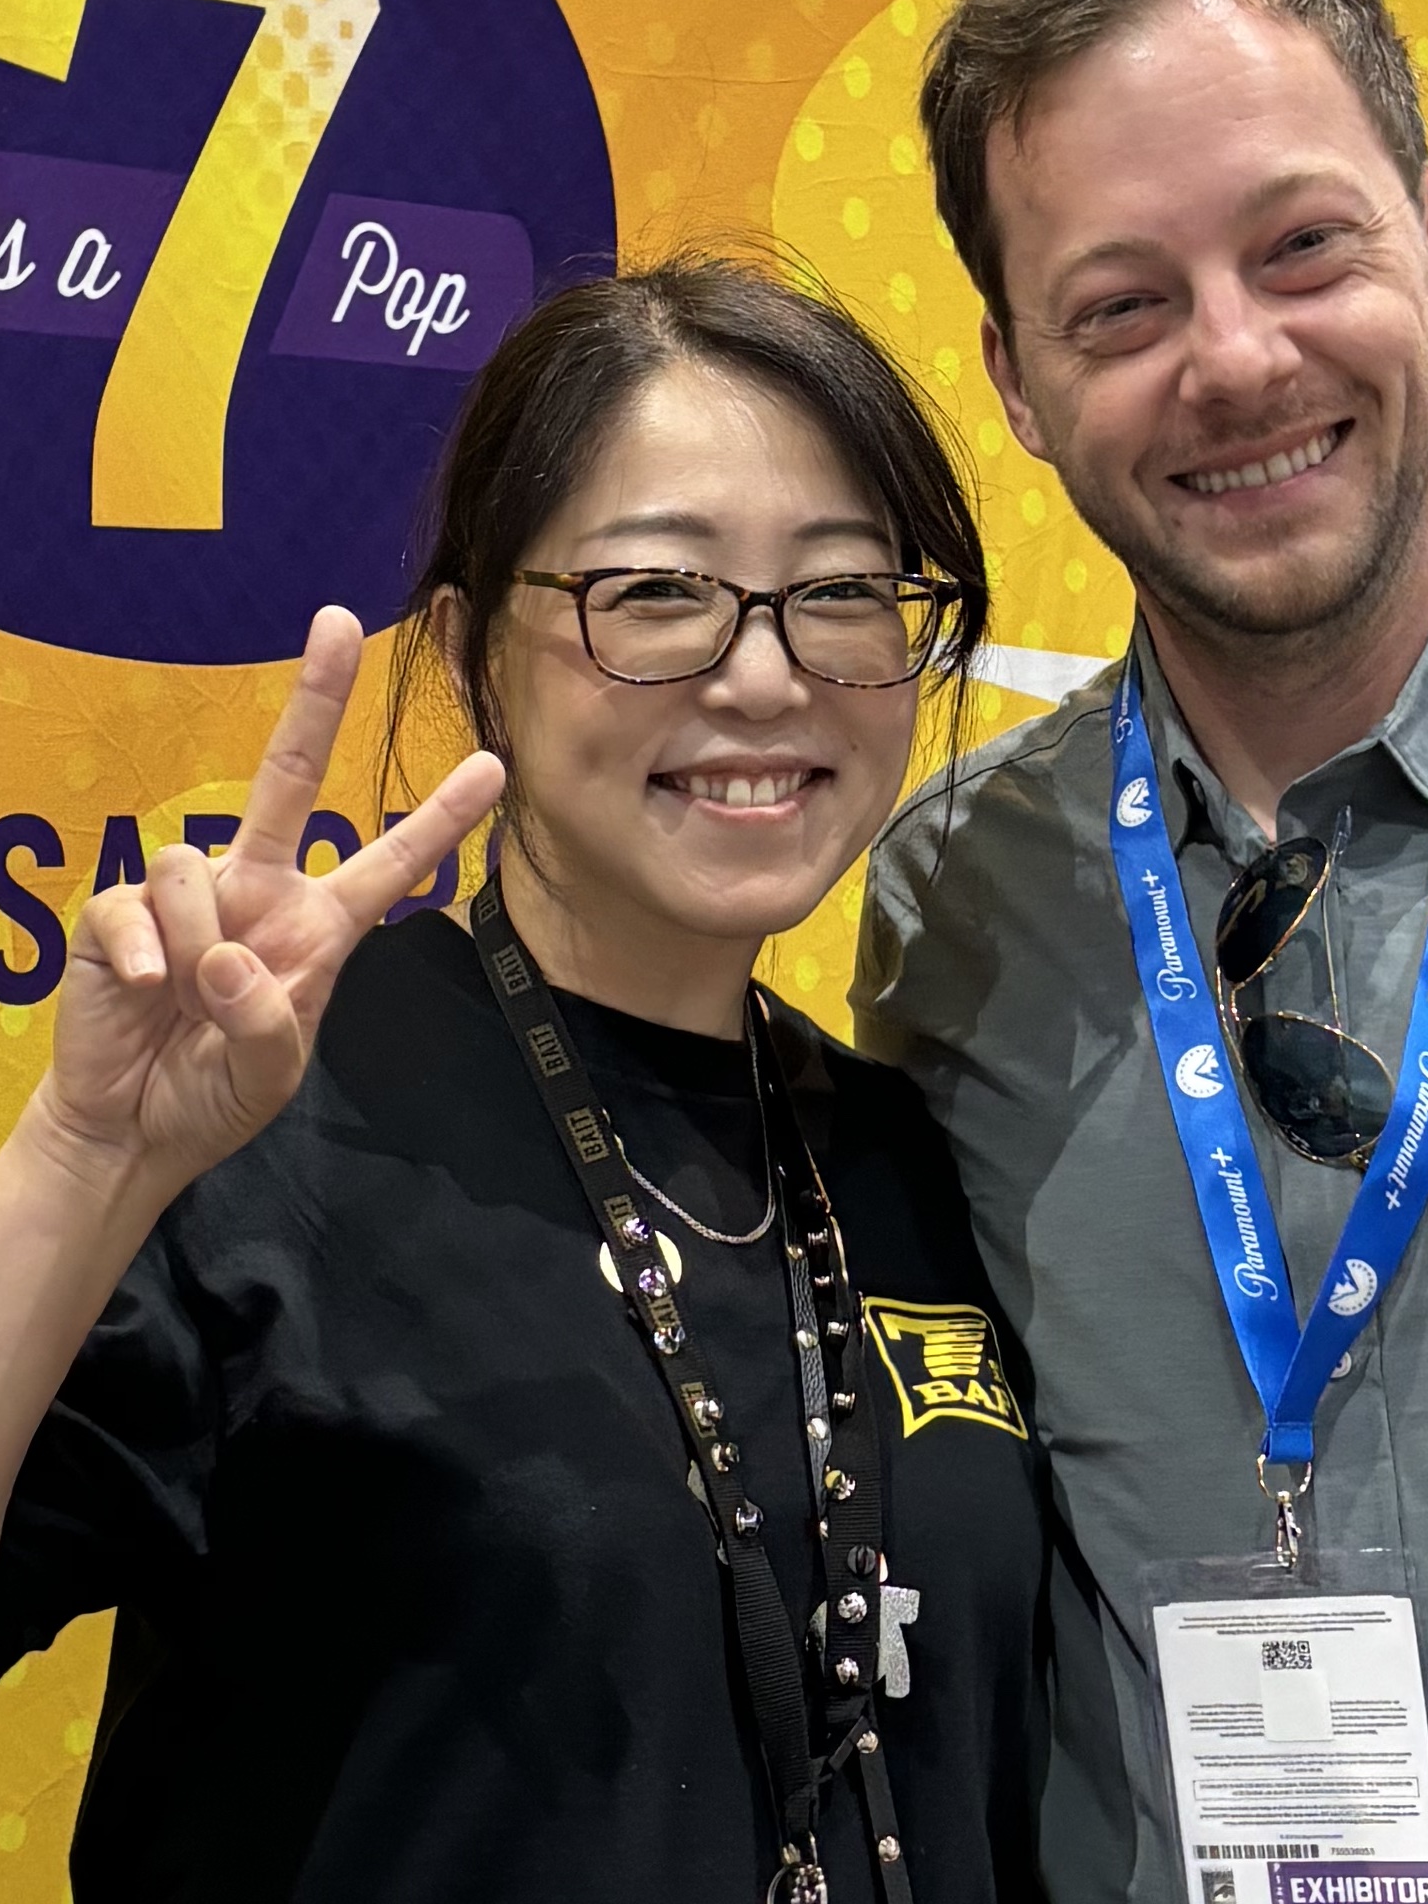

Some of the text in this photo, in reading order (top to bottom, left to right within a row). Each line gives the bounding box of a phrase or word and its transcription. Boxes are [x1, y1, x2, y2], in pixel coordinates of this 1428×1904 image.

[56, 221, 121, 302] a
[330, 220, 471, 357] Pop
[1141, 869, 1198, 1002] Paramount+
[1210, 1146, 1280, 1302] Paramount+
